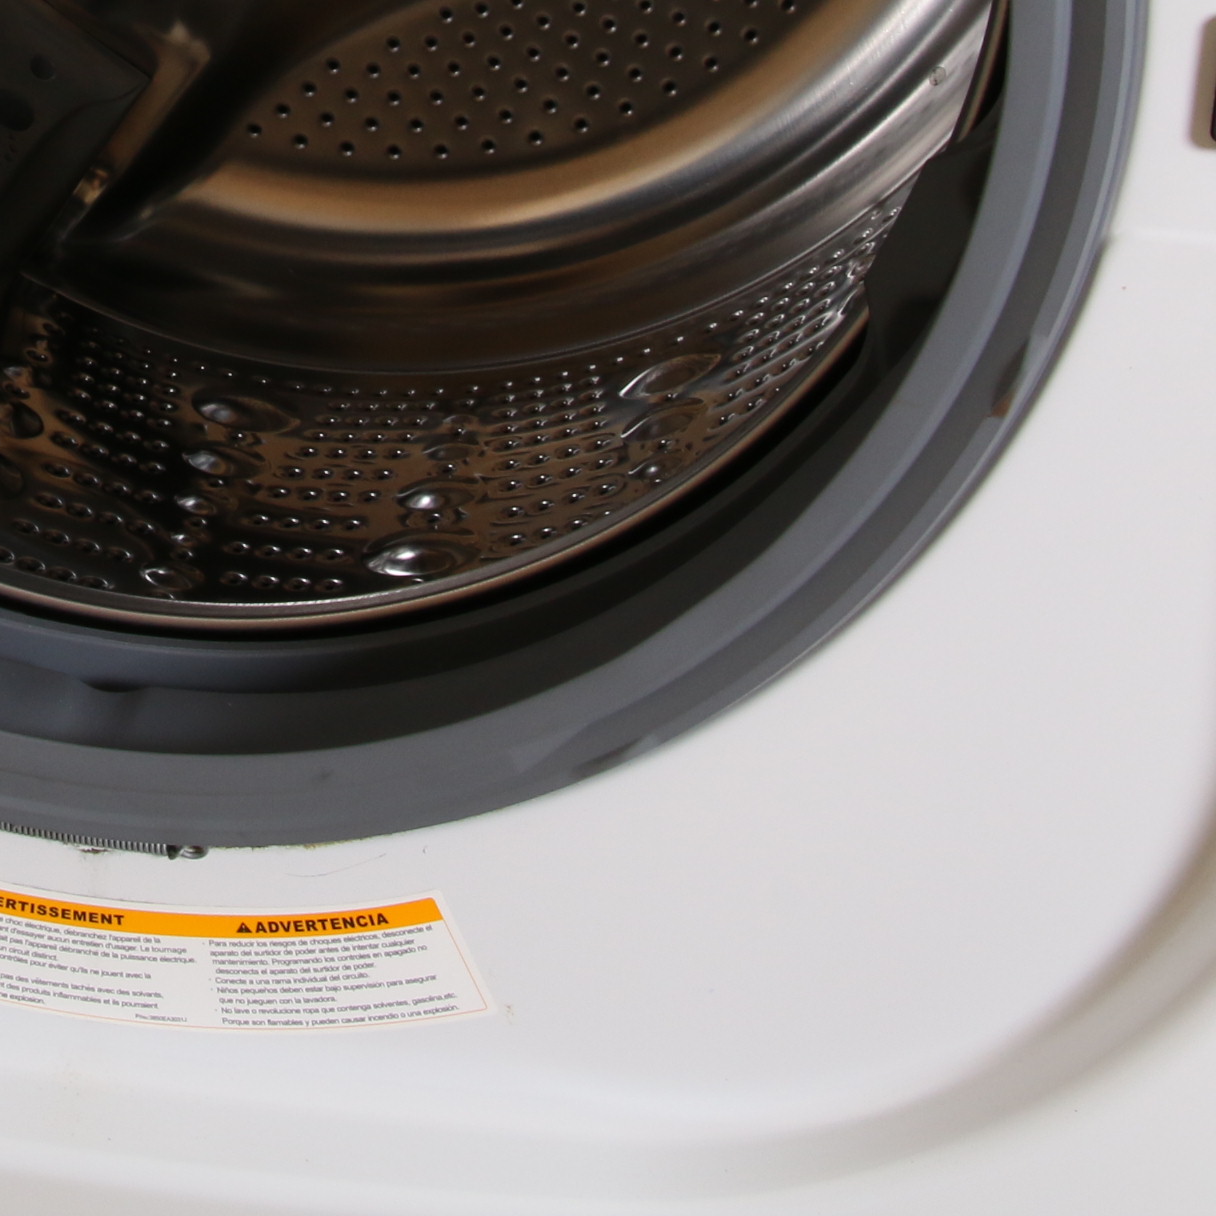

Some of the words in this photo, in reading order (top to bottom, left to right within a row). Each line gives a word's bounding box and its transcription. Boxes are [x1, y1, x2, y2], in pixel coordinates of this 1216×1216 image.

[254, 912, 390, 934] ADVERTENCIA
[7, 946, 31, 957] circuit
[214, 976, 248, 985] Conecte
[254, 978, 271, 986] una
[270, 977, 292, 985] rama
[292, 974, 328, 984] individual
[328, 973, 341, 982] del
[217, 996, 234, 1005] que
[234, 997, 246, 1005] no
[278, 997, 294, 1005] con
